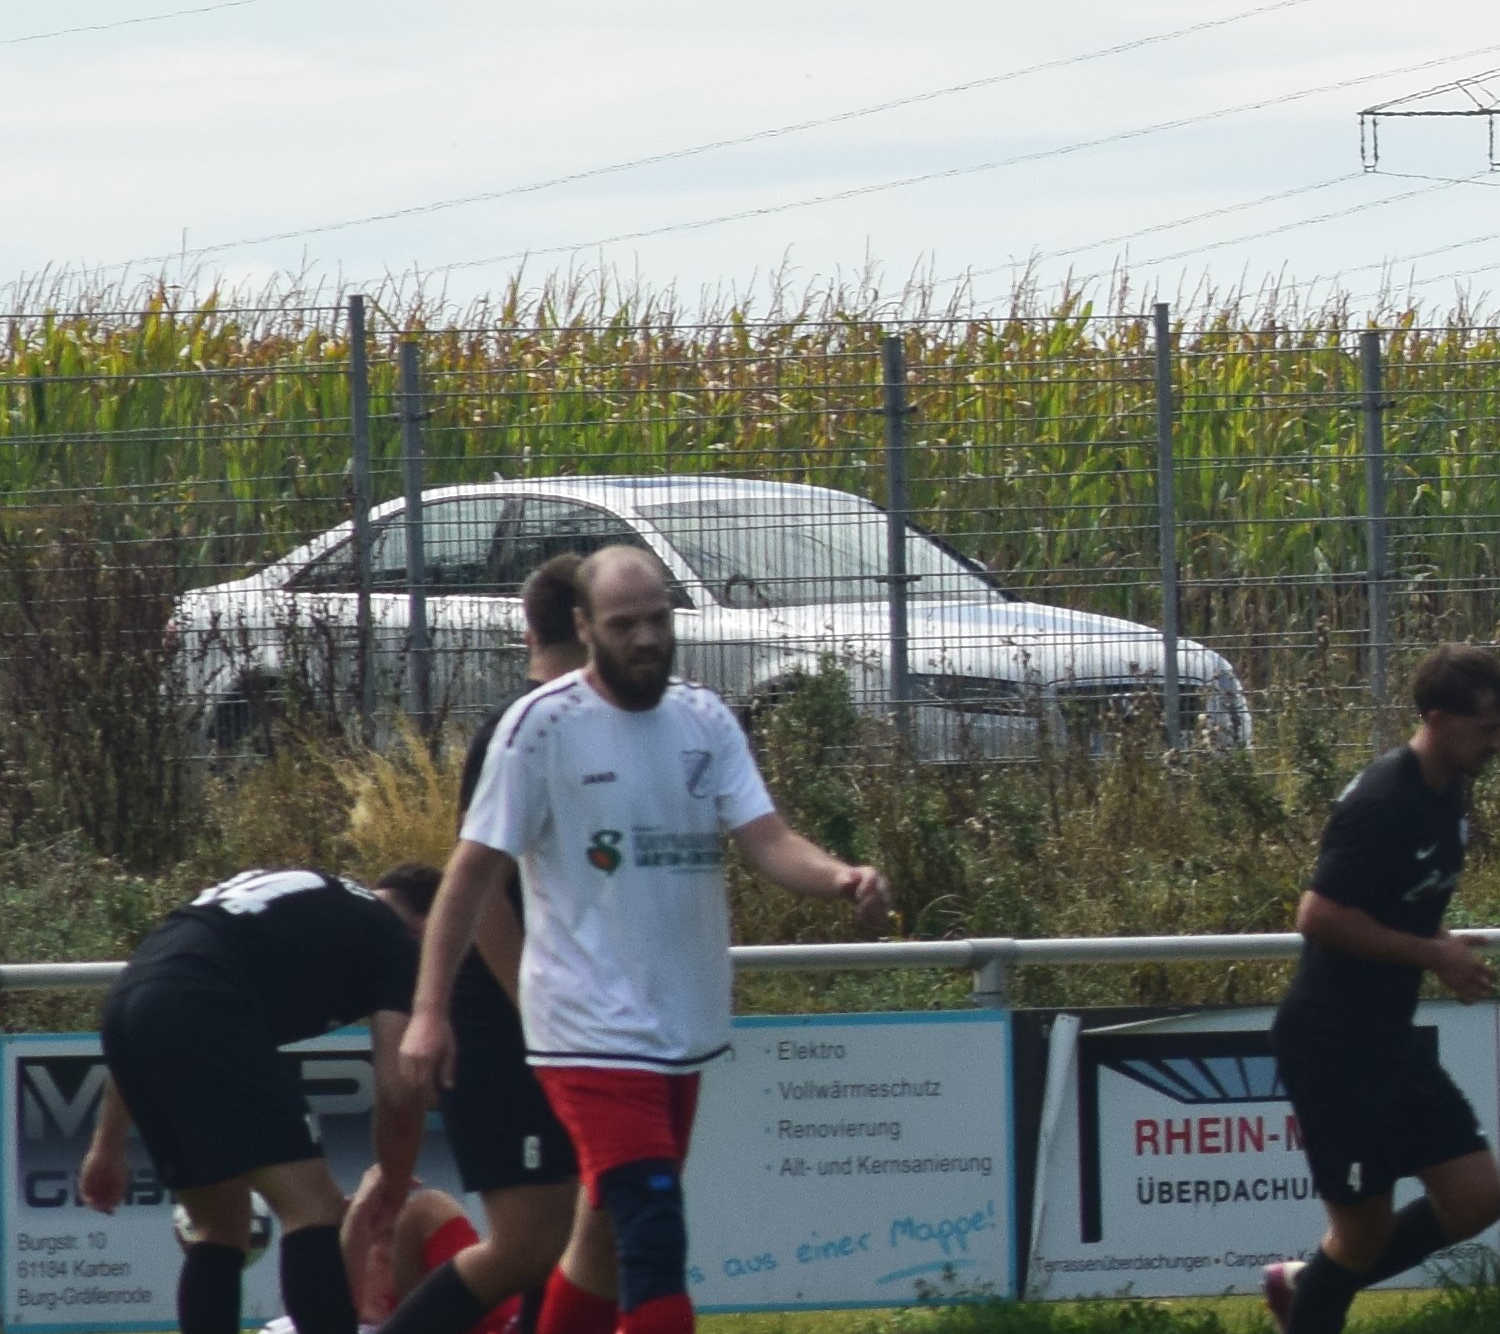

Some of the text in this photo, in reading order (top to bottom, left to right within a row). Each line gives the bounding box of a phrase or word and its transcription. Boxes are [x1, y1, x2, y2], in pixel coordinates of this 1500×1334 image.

[777, 1041, 846, 1061] Elektro
[777, 1079, 942, 1100] Vollwärmeschutz
[777, 1119, 901, 1141] Renovierung
[1134, 1114, 1306, 1156] RHEIN-M
[779, 1154, 993, 1177] Alt- und Kernsanierung
[1136, 1175, 1322, 1205] ÜBERDACHU
[88, 1232, 108, 1250] 10
[723, 1252, 778, 1278] aus
[796, 1230, 872, 1264] einer
[889, 1199, 996, 1255] Mappe!
[73, 1259, 131, 1278] Karben
[17, 1286, 153, 1310] Burg-Gräfenrode
